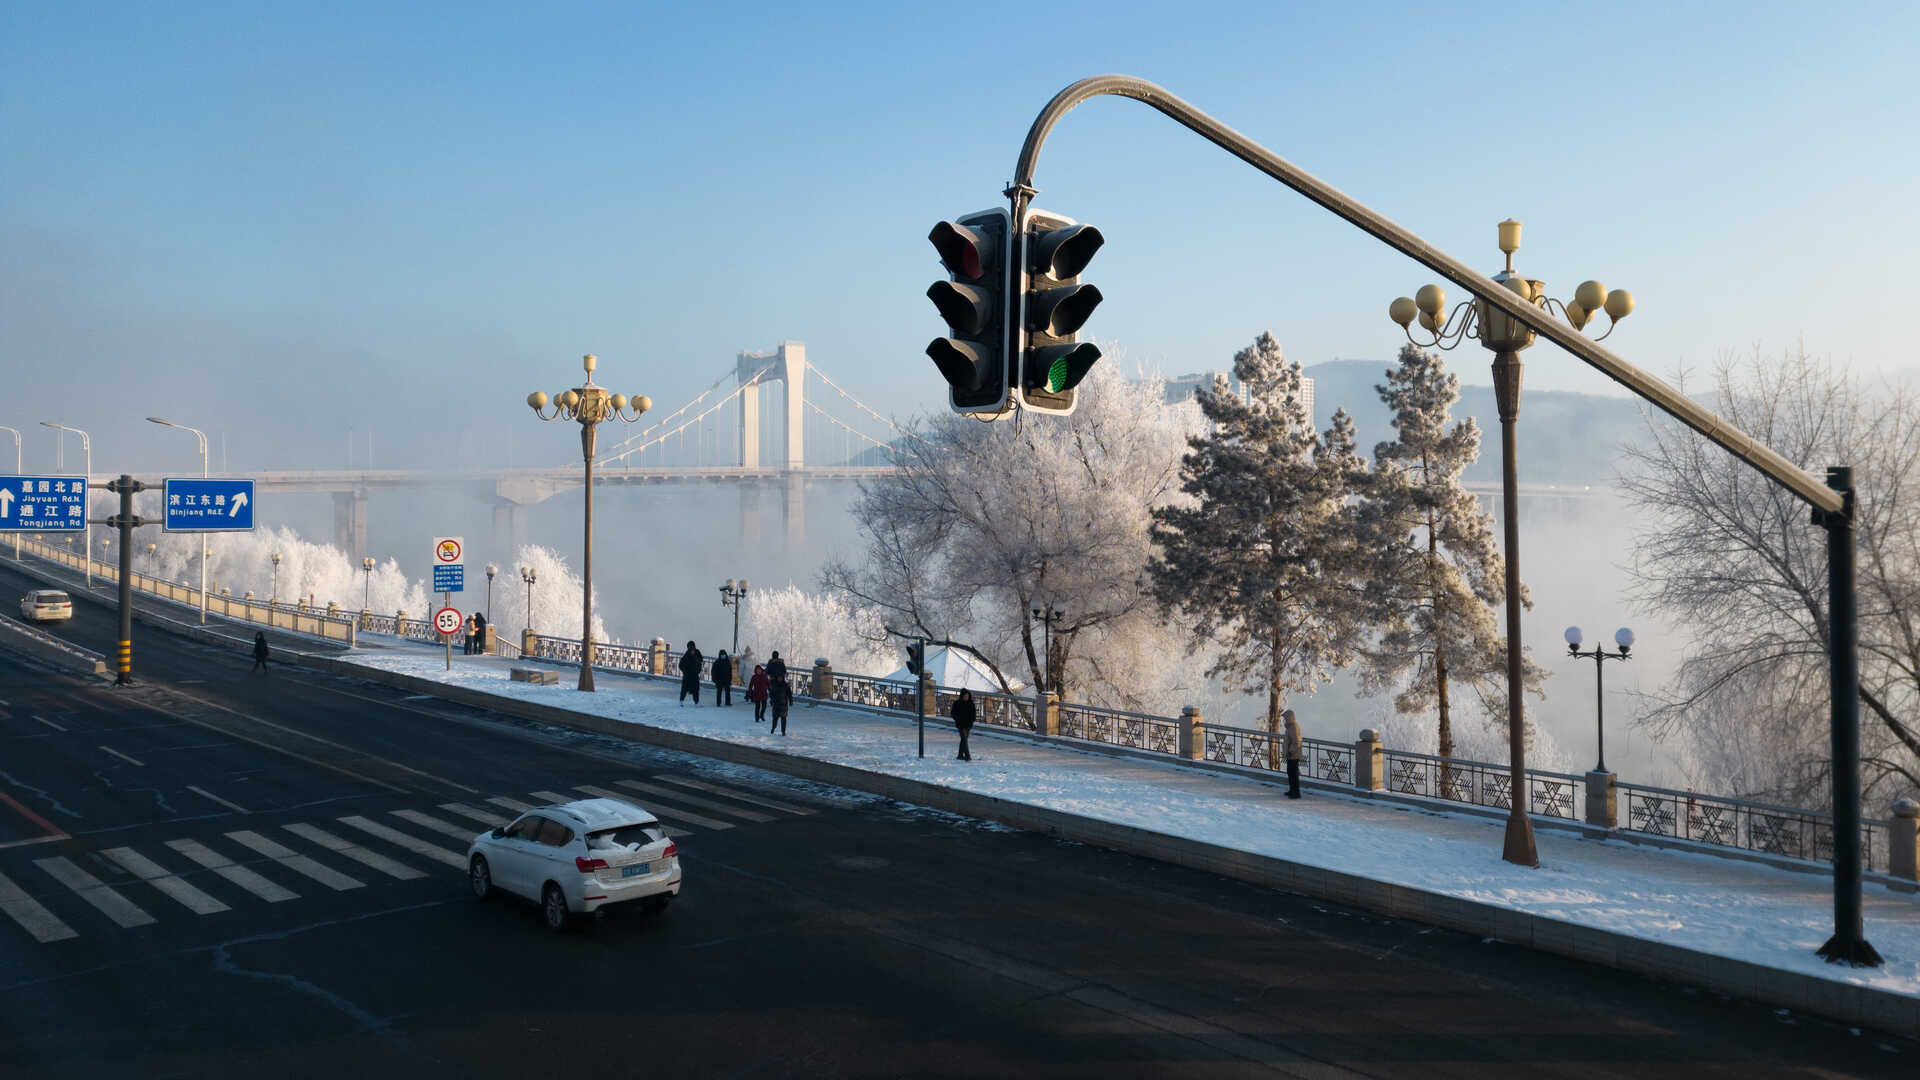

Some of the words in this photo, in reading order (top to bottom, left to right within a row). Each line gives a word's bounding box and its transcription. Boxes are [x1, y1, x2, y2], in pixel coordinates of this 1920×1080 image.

[22, 481, 83, 493] 嘉园北路
[170, 494, 225, 506] 滨江东路
[20, 505, 82, 516] 通江路
[170, 509, 203, 517] Binjiang
[19, 520, 64, 528] Tongjiang
